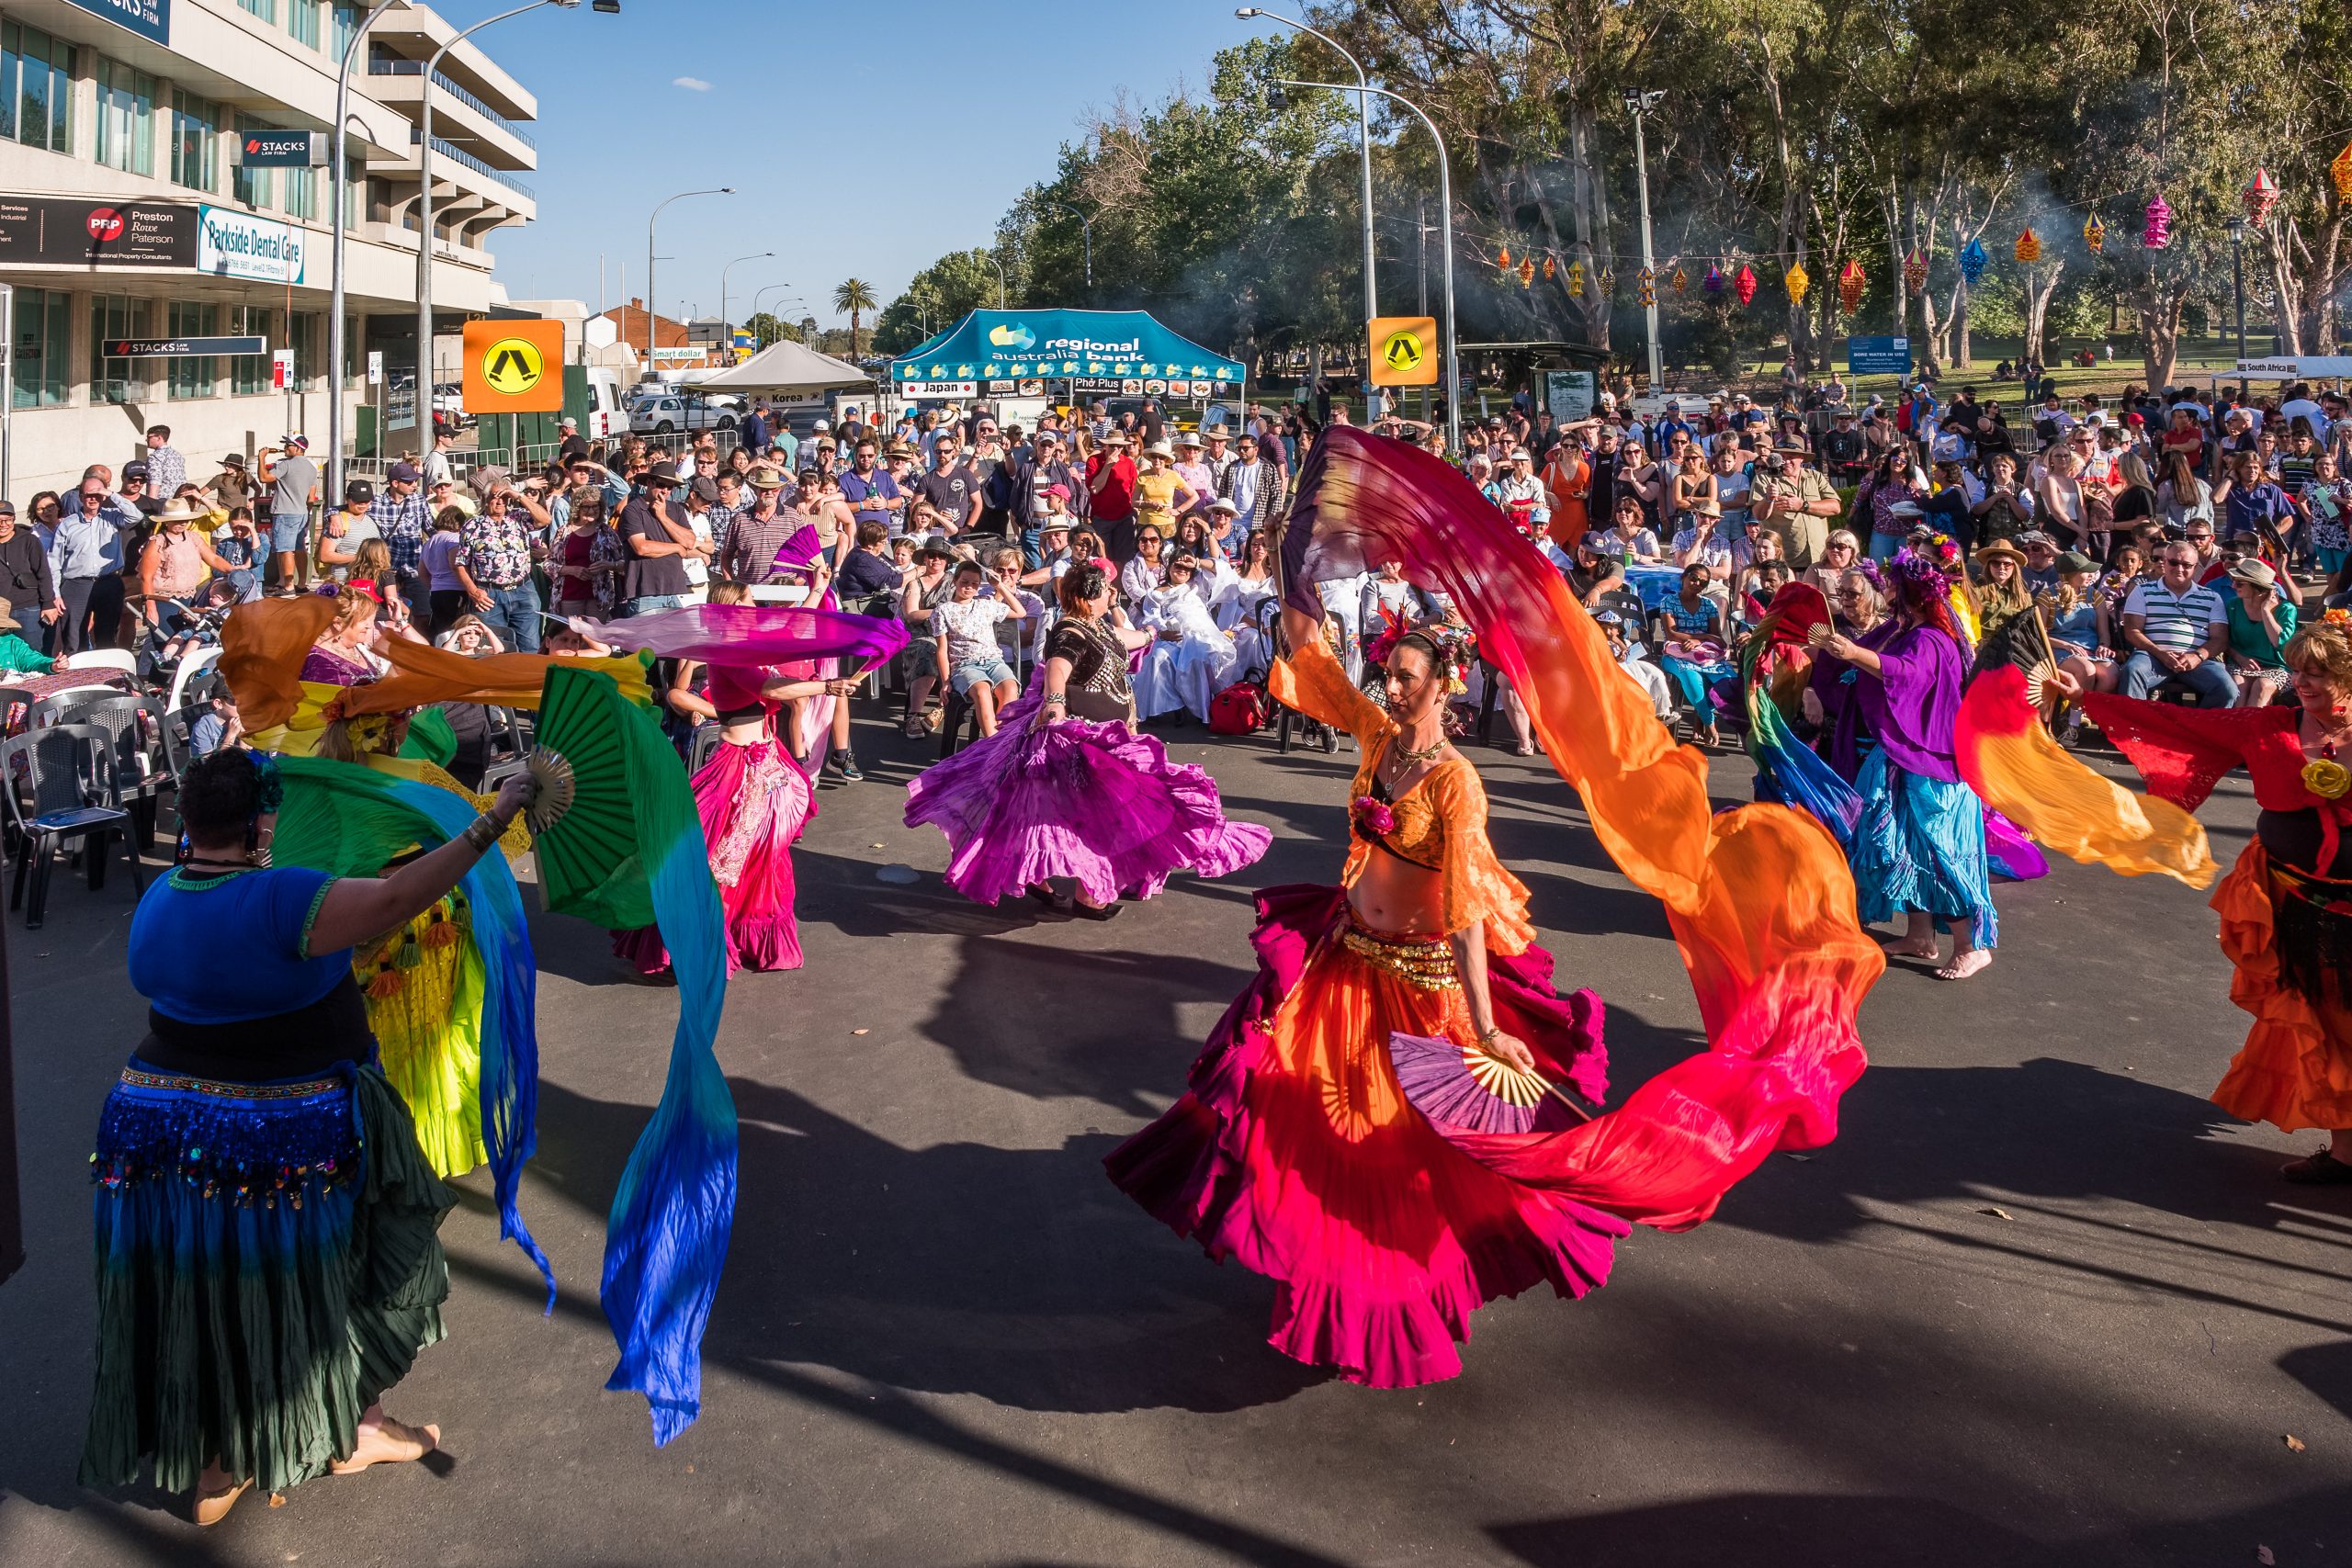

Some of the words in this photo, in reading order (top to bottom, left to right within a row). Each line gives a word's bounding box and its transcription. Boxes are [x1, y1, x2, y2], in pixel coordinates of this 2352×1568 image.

[142, 9, 159, 26] FIRM
[262, 142, 305, 151] STACKS
[132, 211, 174, 221] Preston
[91, 219, 120, 230] PRP
[131, 221, 158, 231] Rowe
[131, 232, 174, 243] Paterson
[209, 220, 249, 254] Parkside
[251, 229, 280, 260] Dental
[281, 235, 300, 263] Care
[132, 343, 175, 352] STACKS
[1046, 338, 1139, 352] regional
[992, 349, 1079, 361] australia
[1086, 351, 1146, 362] bank
[923, 382, 958, 393] Japan
[1098, 378, 1119, 388] Plus
[773, 393, 803, 403] Korea
